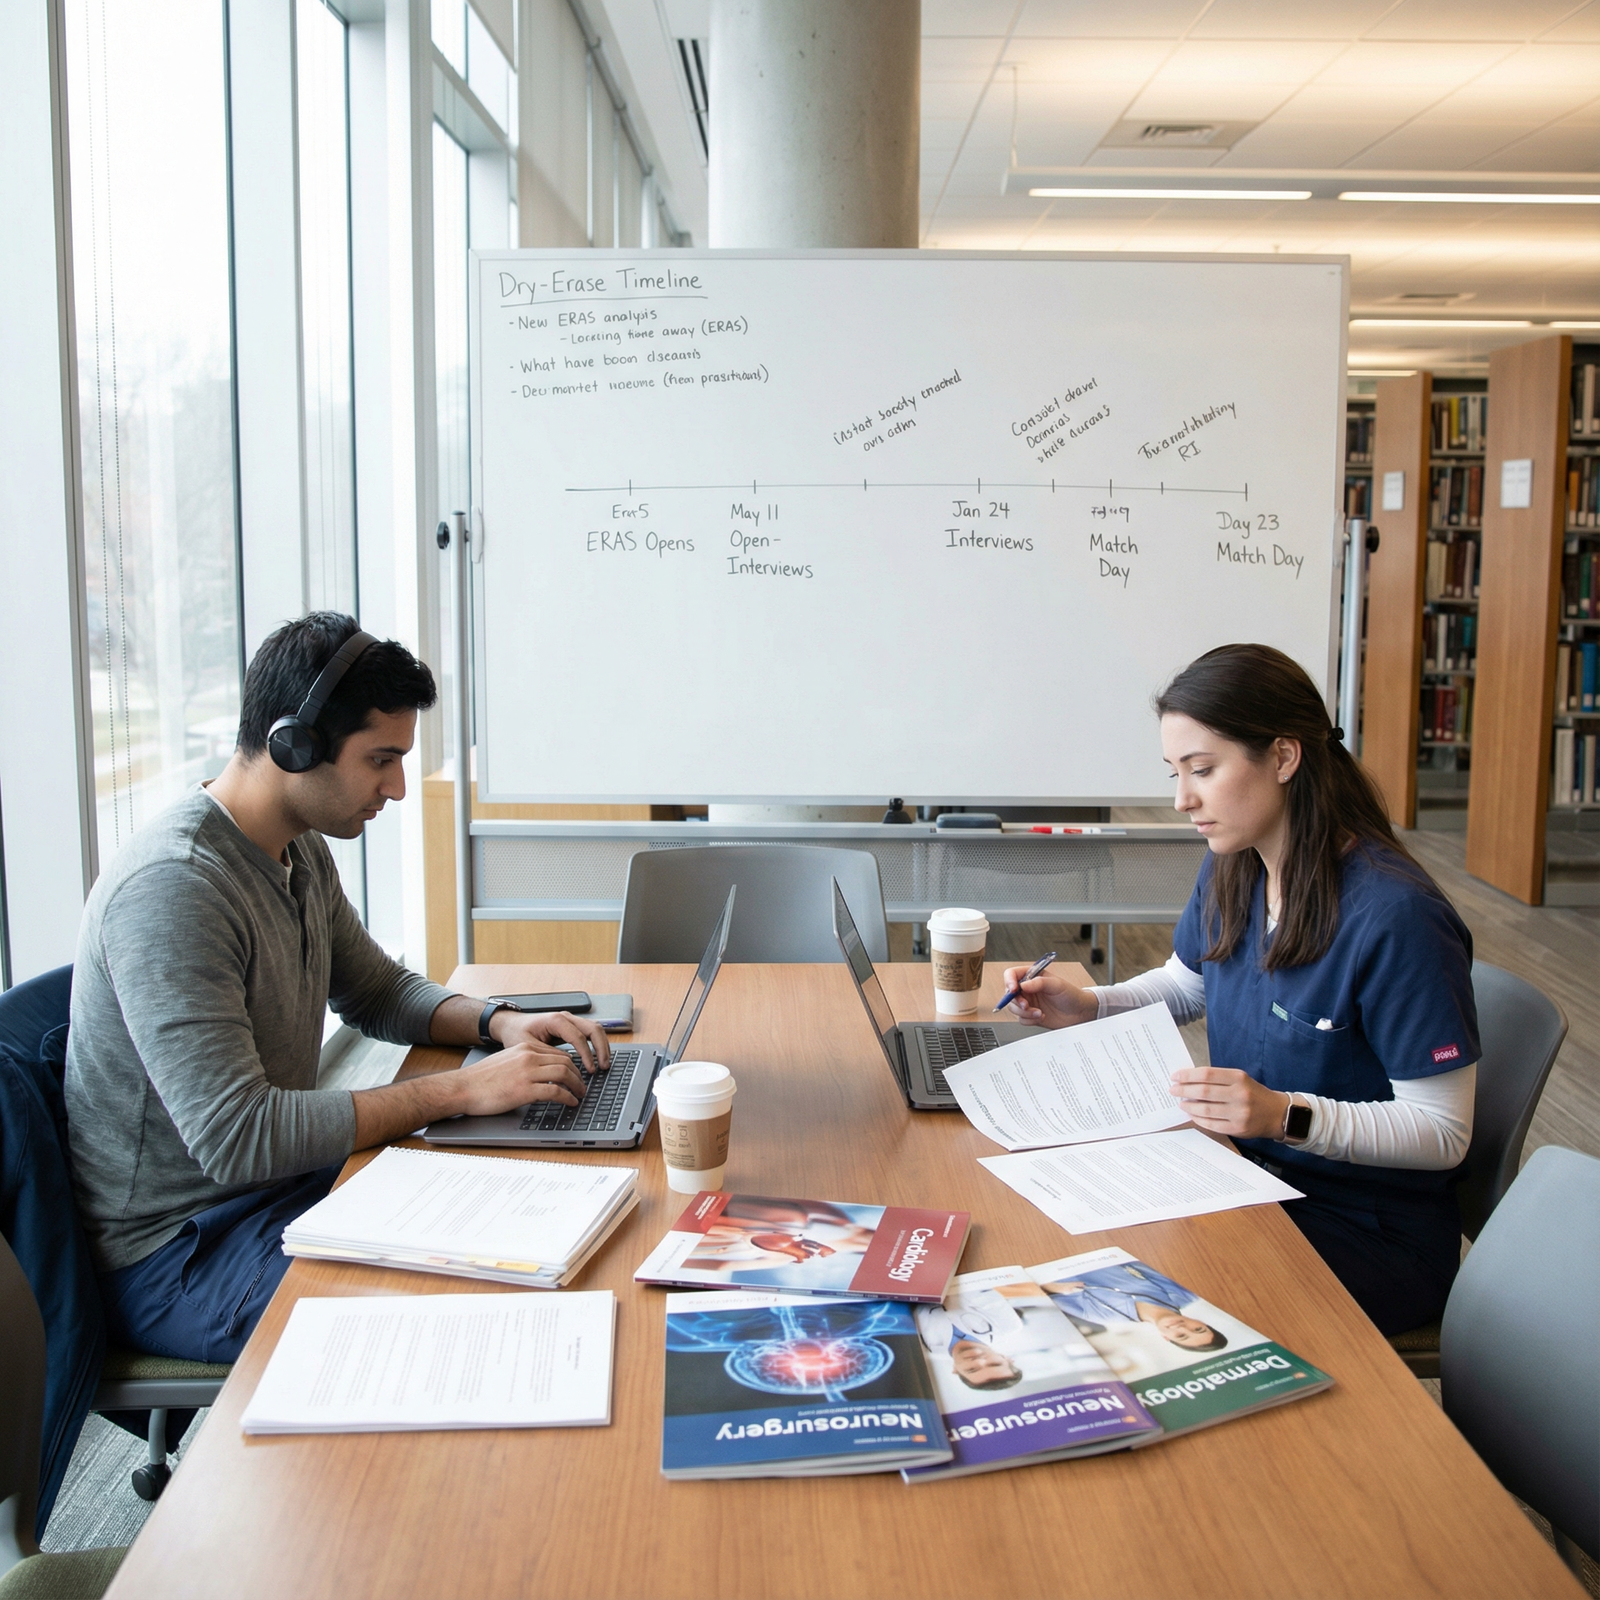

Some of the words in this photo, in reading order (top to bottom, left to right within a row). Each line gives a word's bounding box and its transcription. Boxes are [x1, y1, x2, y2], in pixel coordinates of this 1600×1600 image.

[498, 269, 607, 306] Dry-Erase
[615, 267, 703, 290] Timeline
[558, 310, 596, 328] ERAS
[603, 307, 658, 326] analysis
[661, 326, 696, 339] away
[700, 315, 749, 337] (ERAS)
[563, 355, 595, 369] have
[730, 502, 761, 528] May
[951, 499, 981, 519] Jan
[988, 501, 1011, 520] 24
[1215, 510, 1251, 540] Day
[1256, 513, 1280, 531] 23
[586, 530, 638, 553] ERAS
[645, 530, 696, 559] Opens
[943, 528, 1034, 552] Interviews
[1089, 532, 1139, 555] Match
[726, 555, 814, 579] Interviews
[1098, 557, 1131, 589] Day
[1216, 541, 1267, 565] Match
[1272, 543, 1305, 580] Day
[887, 1227, 935, 1283] Cardiology
[715, 1412, 924, 1441] Neurosurgery
[947, 1395, 1126, 1442] Neurosurger
